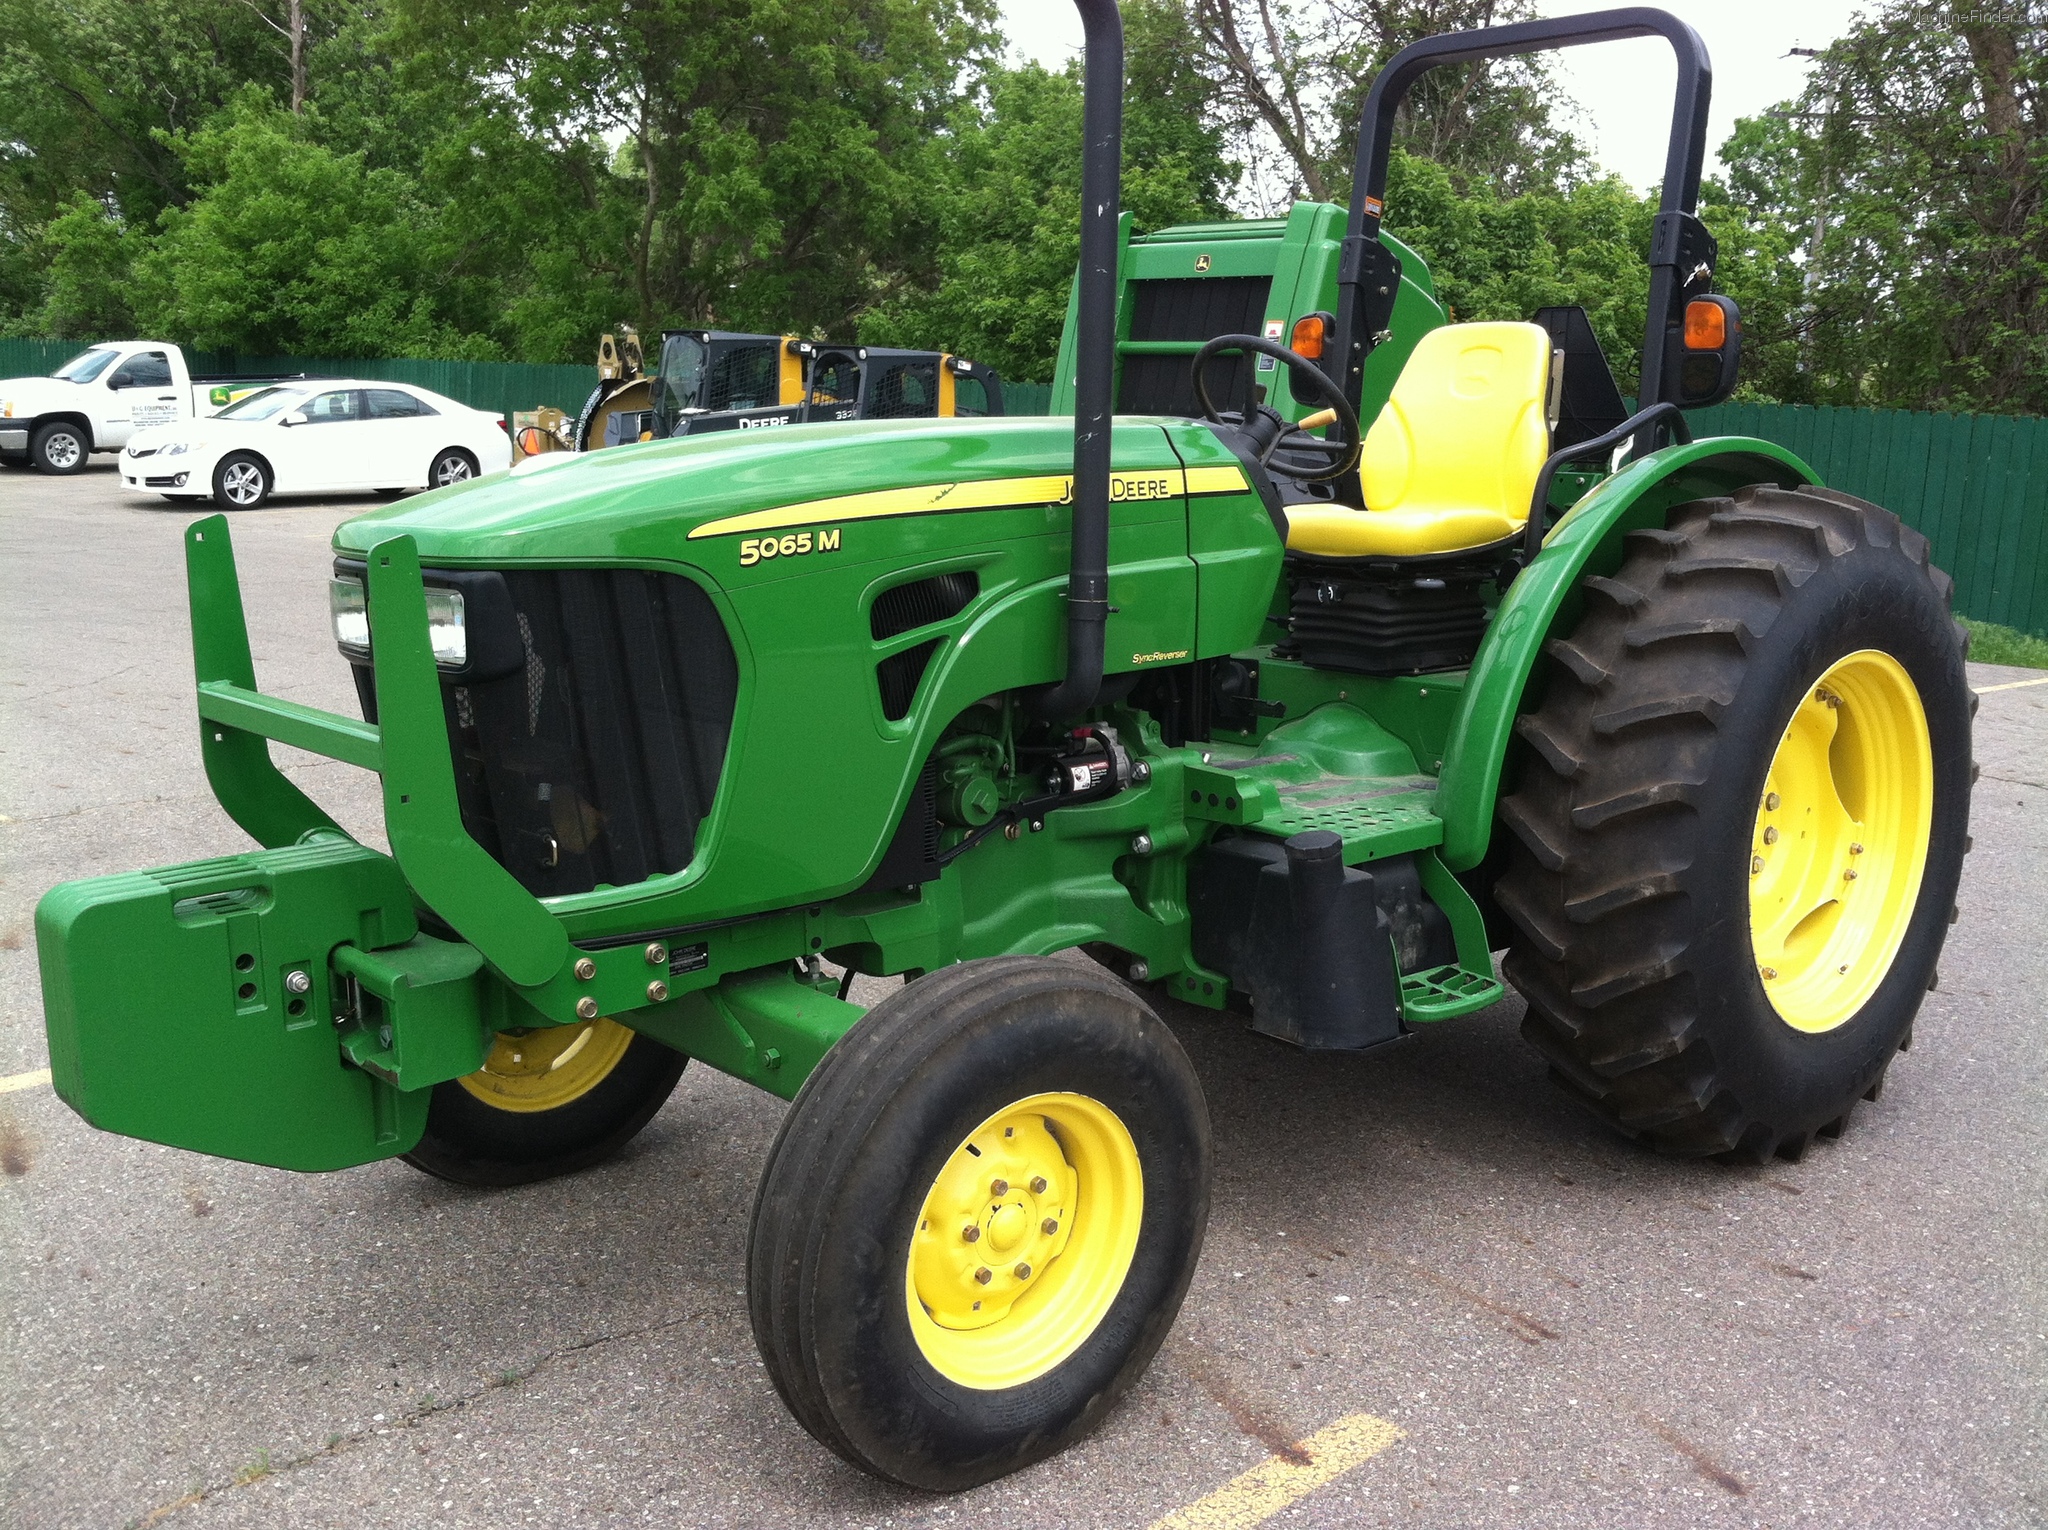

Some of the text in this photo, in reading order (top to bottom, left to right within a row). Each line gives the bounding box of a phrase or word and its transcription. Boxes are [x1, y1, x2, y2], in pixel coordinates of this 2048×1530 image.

[739, 416, 789, 429] DEERE
[1112, 479, 1169, 498] DEERE
[740, 528, 841, 566] 5065 M
[1132, 650, 1188, 664] SyncReverser
